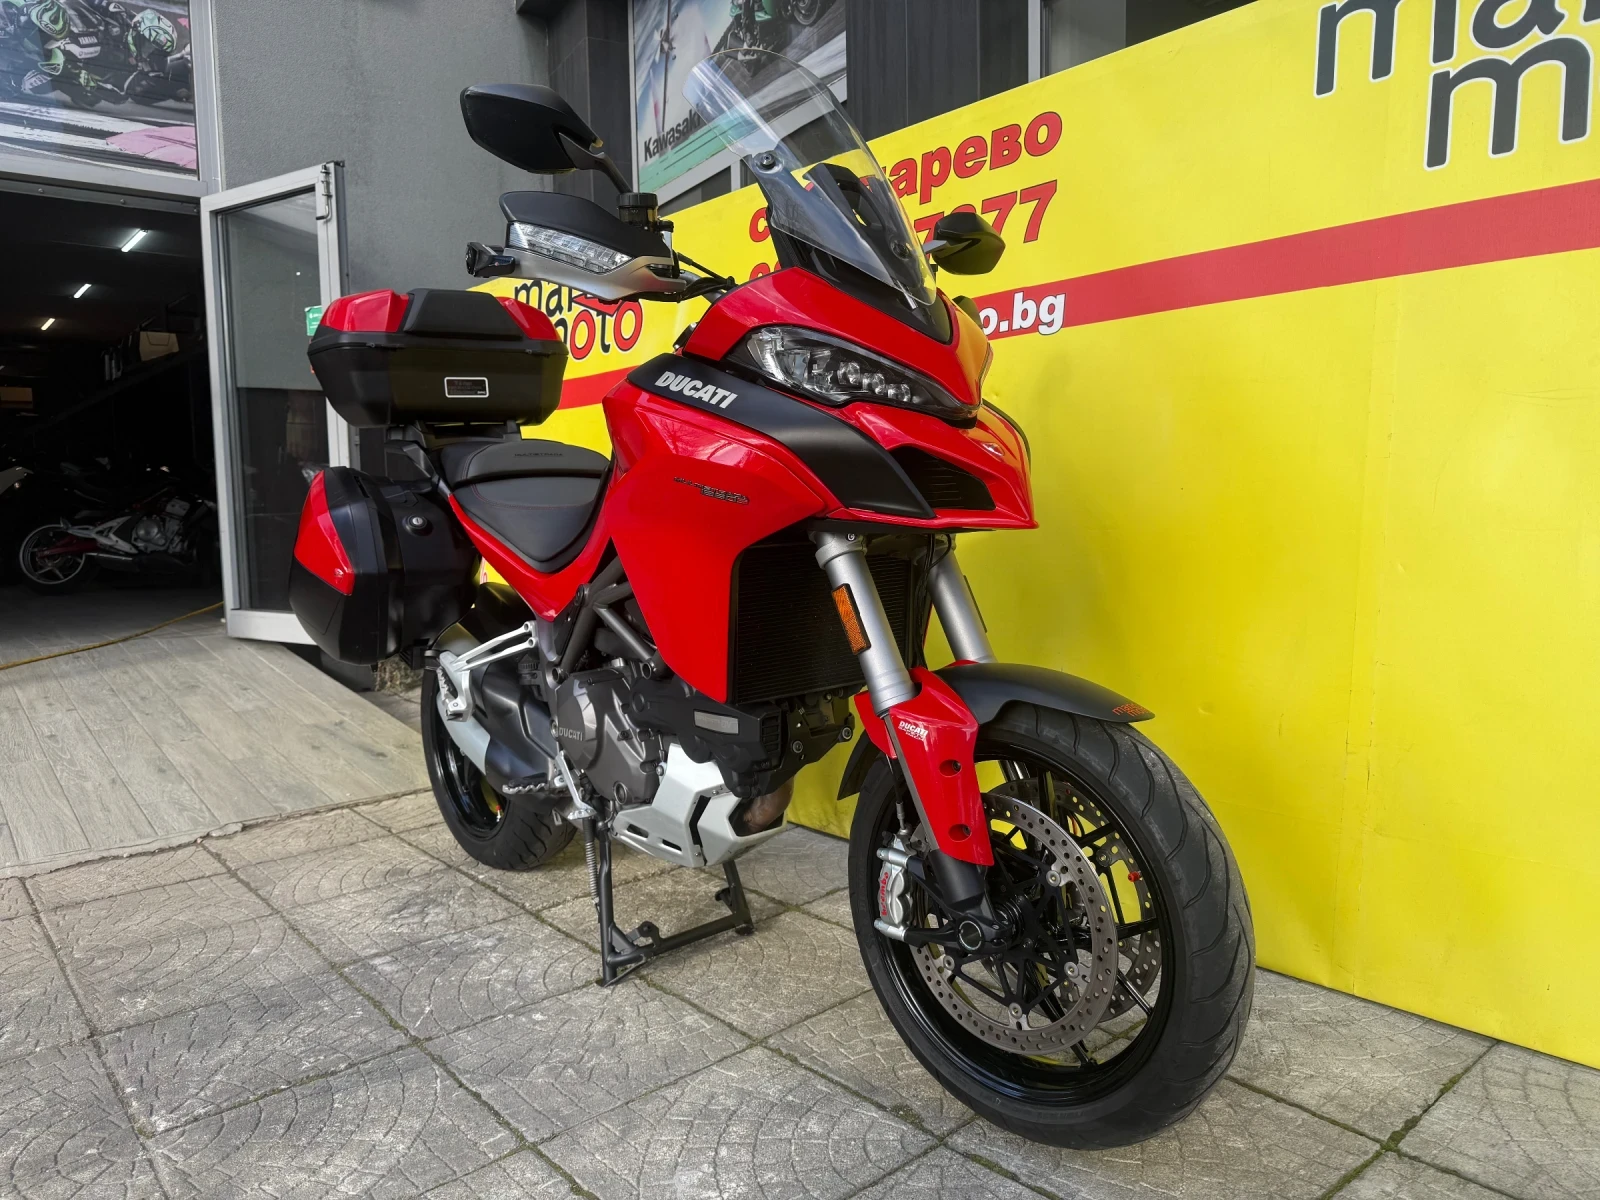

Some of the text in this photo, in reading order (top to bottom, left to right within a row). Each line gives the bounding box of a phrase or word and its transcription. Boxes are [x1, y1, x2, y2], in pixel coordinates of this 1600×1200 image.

[882, 111, 1063, 206] арево
[654, 370, 739, 409] DUCATI
[558, 726, 583, 742] DUCATI
[898, 720, 929, 737] DUCATI
[880, 871, 889, 916] brembo
